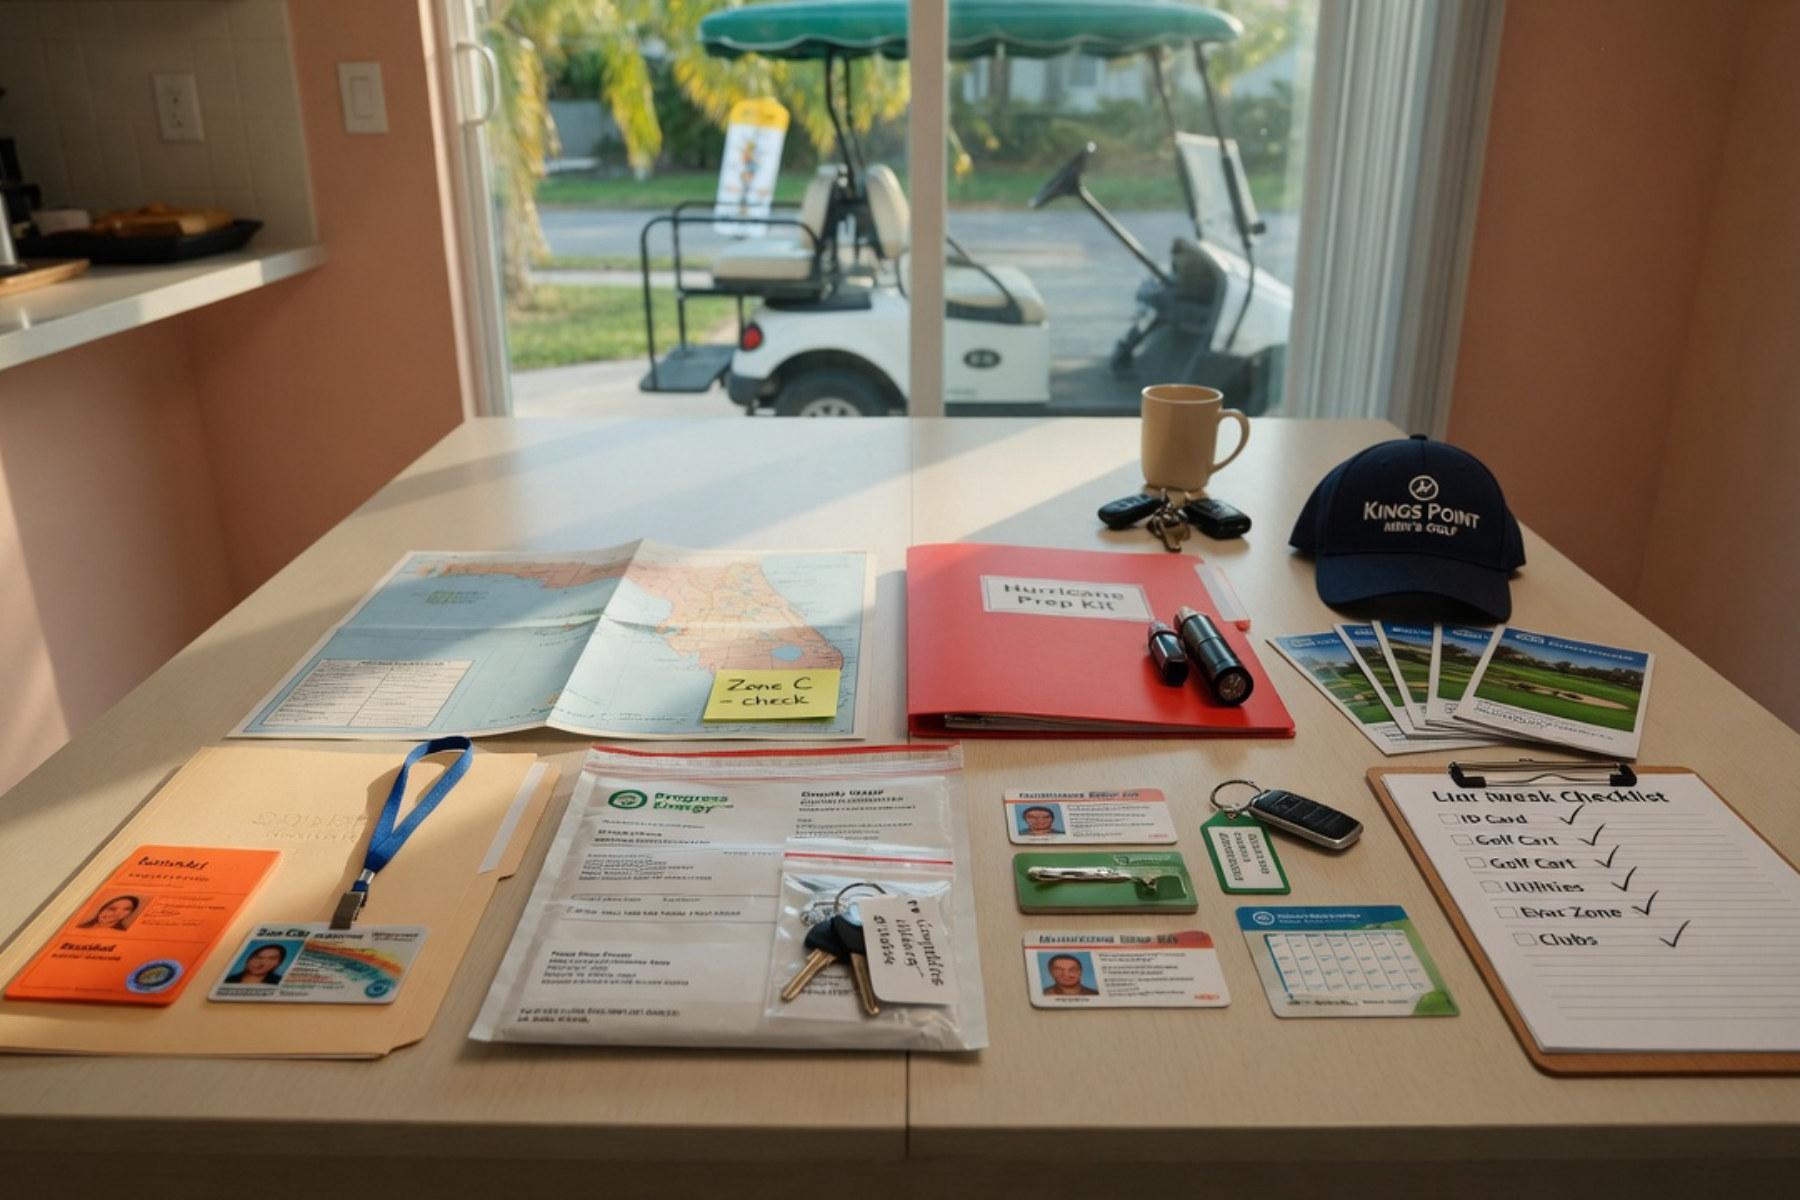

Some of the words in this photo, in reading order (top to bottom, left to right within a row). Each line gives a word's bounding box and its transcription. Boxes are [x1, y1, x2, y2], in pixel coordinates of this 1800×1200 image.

[1363, 501, 1423, 520] KINGS
[1427, 503, 1480, 528] POINT
[1004, 584, 1124, 600] Hurricane
[1081, 599, 1115, 611] Kit
[727, 678, 782, 691] Zone
[793, 677, 813, 690] C
[742, 695, 809, 706] check
[1560, 790, 1670, 805] Checklist
[1460, 814, 1481, 824] ID
[1485, 813, 1528, 824] Card
[1476, 834, 1514, 845] Golf
[1518, 835, 1559, 846] Cart
[1490, 857, 1530, 869] Golf
[1534, 858, 1577, 869] Cart
[1569, 906, 1623, 918] Zone
[1539, 932, 1598, 946] Clubs
